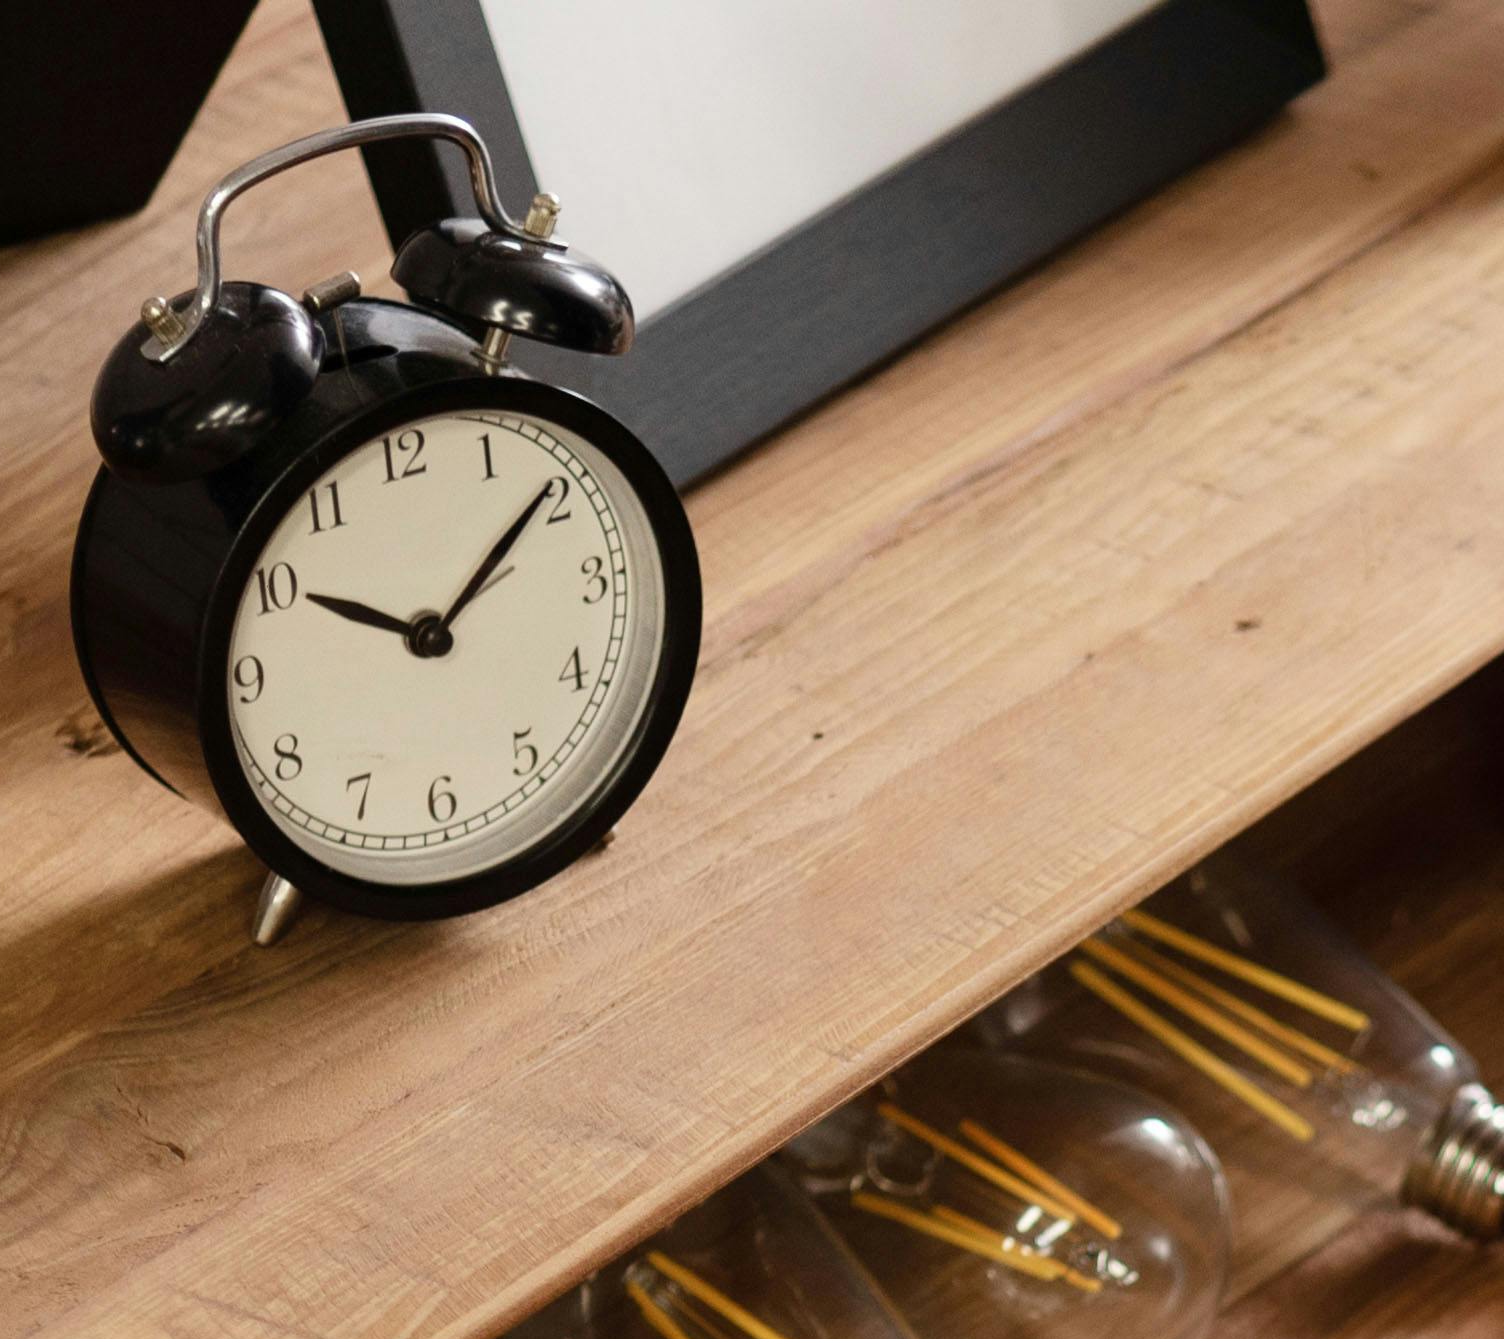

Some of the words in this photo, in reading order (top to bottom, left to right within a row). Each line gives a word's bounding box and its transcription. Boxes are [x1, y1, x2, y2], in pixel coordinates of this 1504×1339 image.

[378, 428, 428, 484] 12
[478, 433, 499, 482] 1
[305, 480, 348, 535] 11
[545, 475, 572, 525] 2
[255, 561, 299, 616] 10
[580, 556, 609, 605] 3
[233, 654, 265, 704] 9
[557, 645, 589, 694] 4
[273, 732, 304, 781] 8
[510, 727, 539, 777] 5
[345, 772, 373, 821] 7
[427, 775, 458, 824] 6
